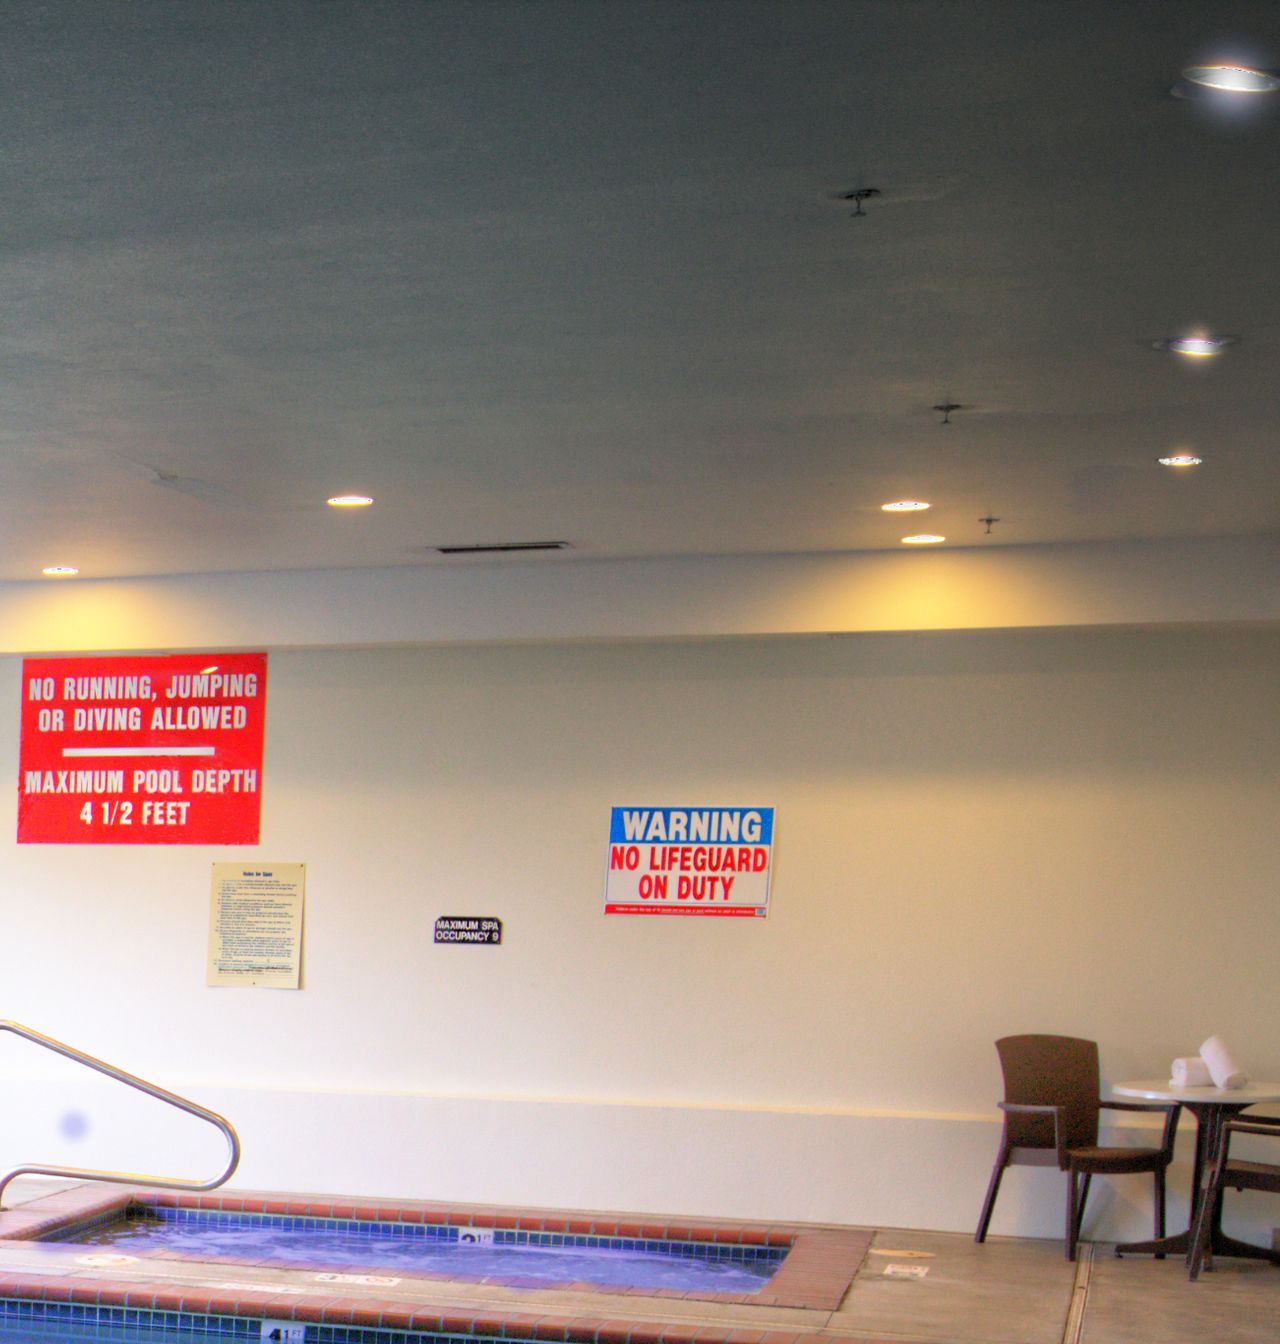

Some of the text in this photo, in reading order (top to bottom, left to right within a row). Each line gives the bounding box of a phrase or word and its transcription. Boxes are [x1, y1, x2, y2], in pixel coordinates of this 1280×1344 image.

[29, 673, 257, 702] NO RUNNING, JUMPING
[38, 705, 247, 732] OR DIVING ALLOWED
[25, 769, 257, 794] MAXIMUM POOL DEPTH
[80, 800, 190, 825] 4 1/2 FEET
[622, 810, 762, 843] WARNING
[610, 845, 767, 872] NO LIFEGUARD
[639, 875, 735, 900] ON DUTY
[436, 920, 499, 931] MAXIMUM SPA
[436, 930, 490, 941] OCCUPANCY
